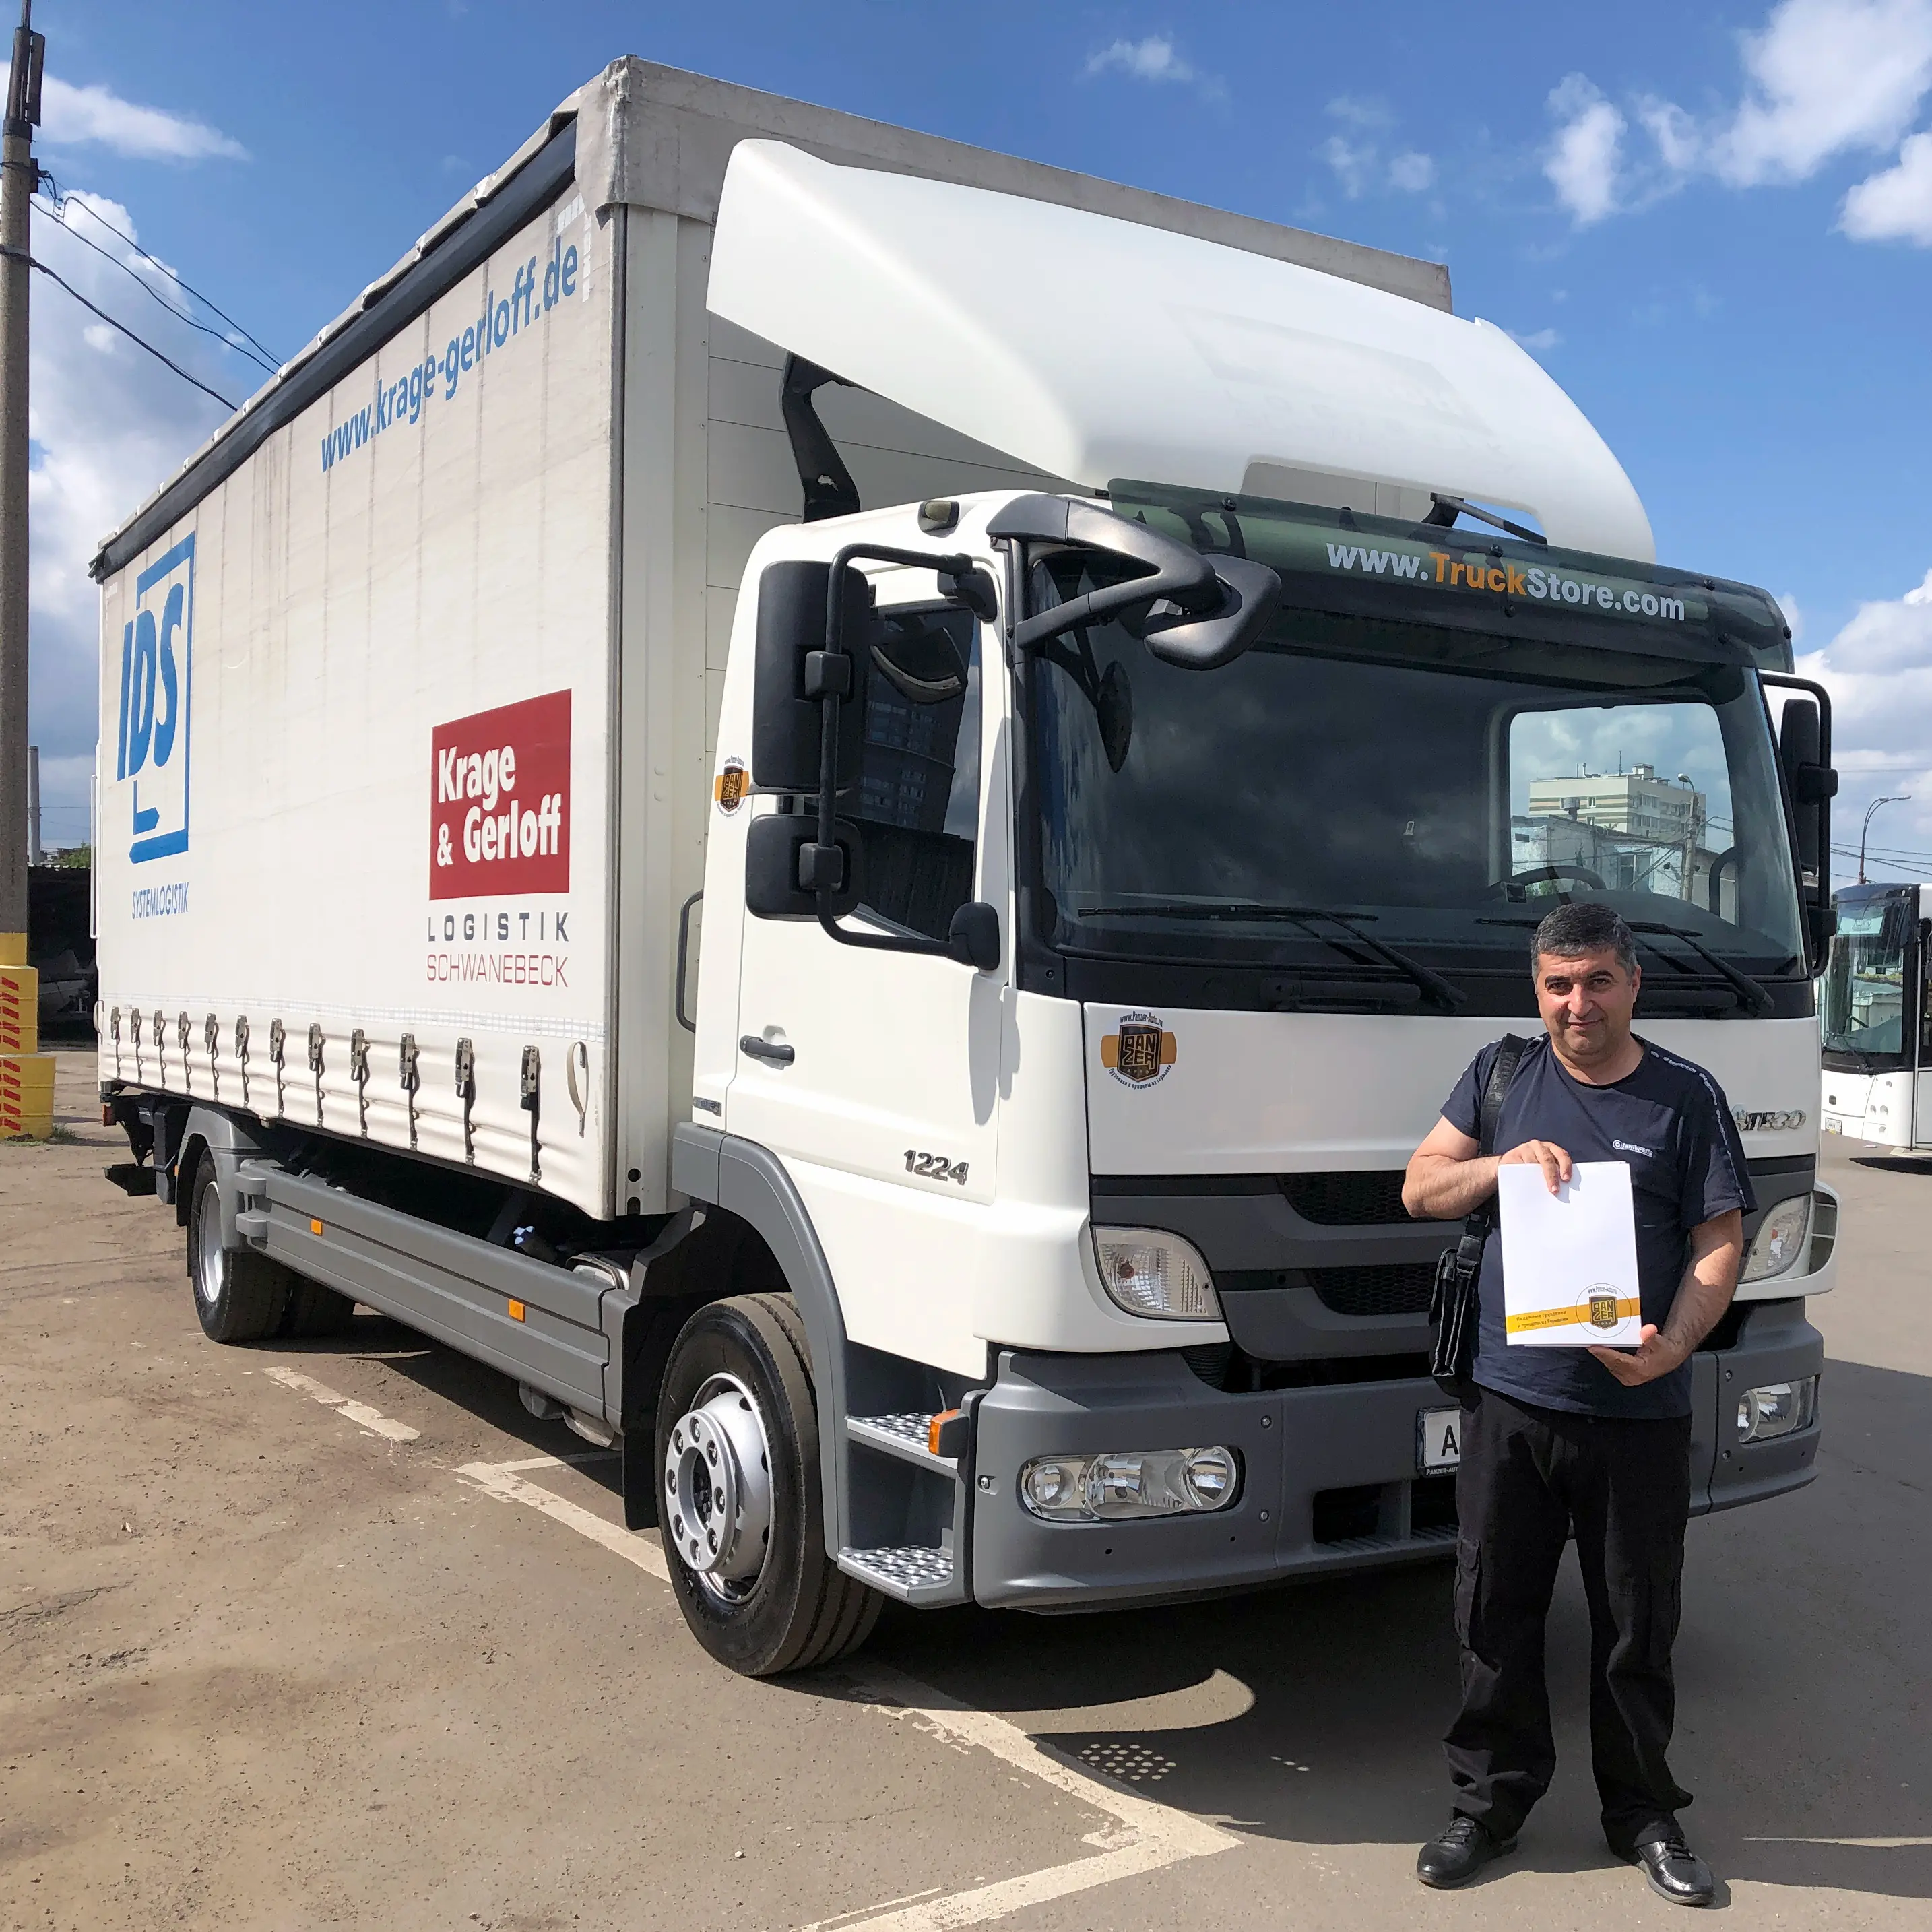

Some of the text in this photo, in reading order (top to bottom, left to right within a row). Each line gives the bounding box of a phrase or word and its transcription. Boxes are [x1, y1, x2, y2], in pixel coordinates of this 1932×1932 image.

[321, 236, 578, 472] www.krage-gerloff.de
[1326, 542, 1685, 620] www.TruckStore.com
[117, 583, 184, 782] IDS
[438, 745, 516, 811] Krage
[437, 793, 562, 867] & Gerloff
[132, 882, 189, 920] SYSTEMLOGISTIK
[428, 911, 569, 942] LOGISTIK
[426, 953, 569, 988] SCHWANEBECK
[903, 1149, 969, 1186] 1224
